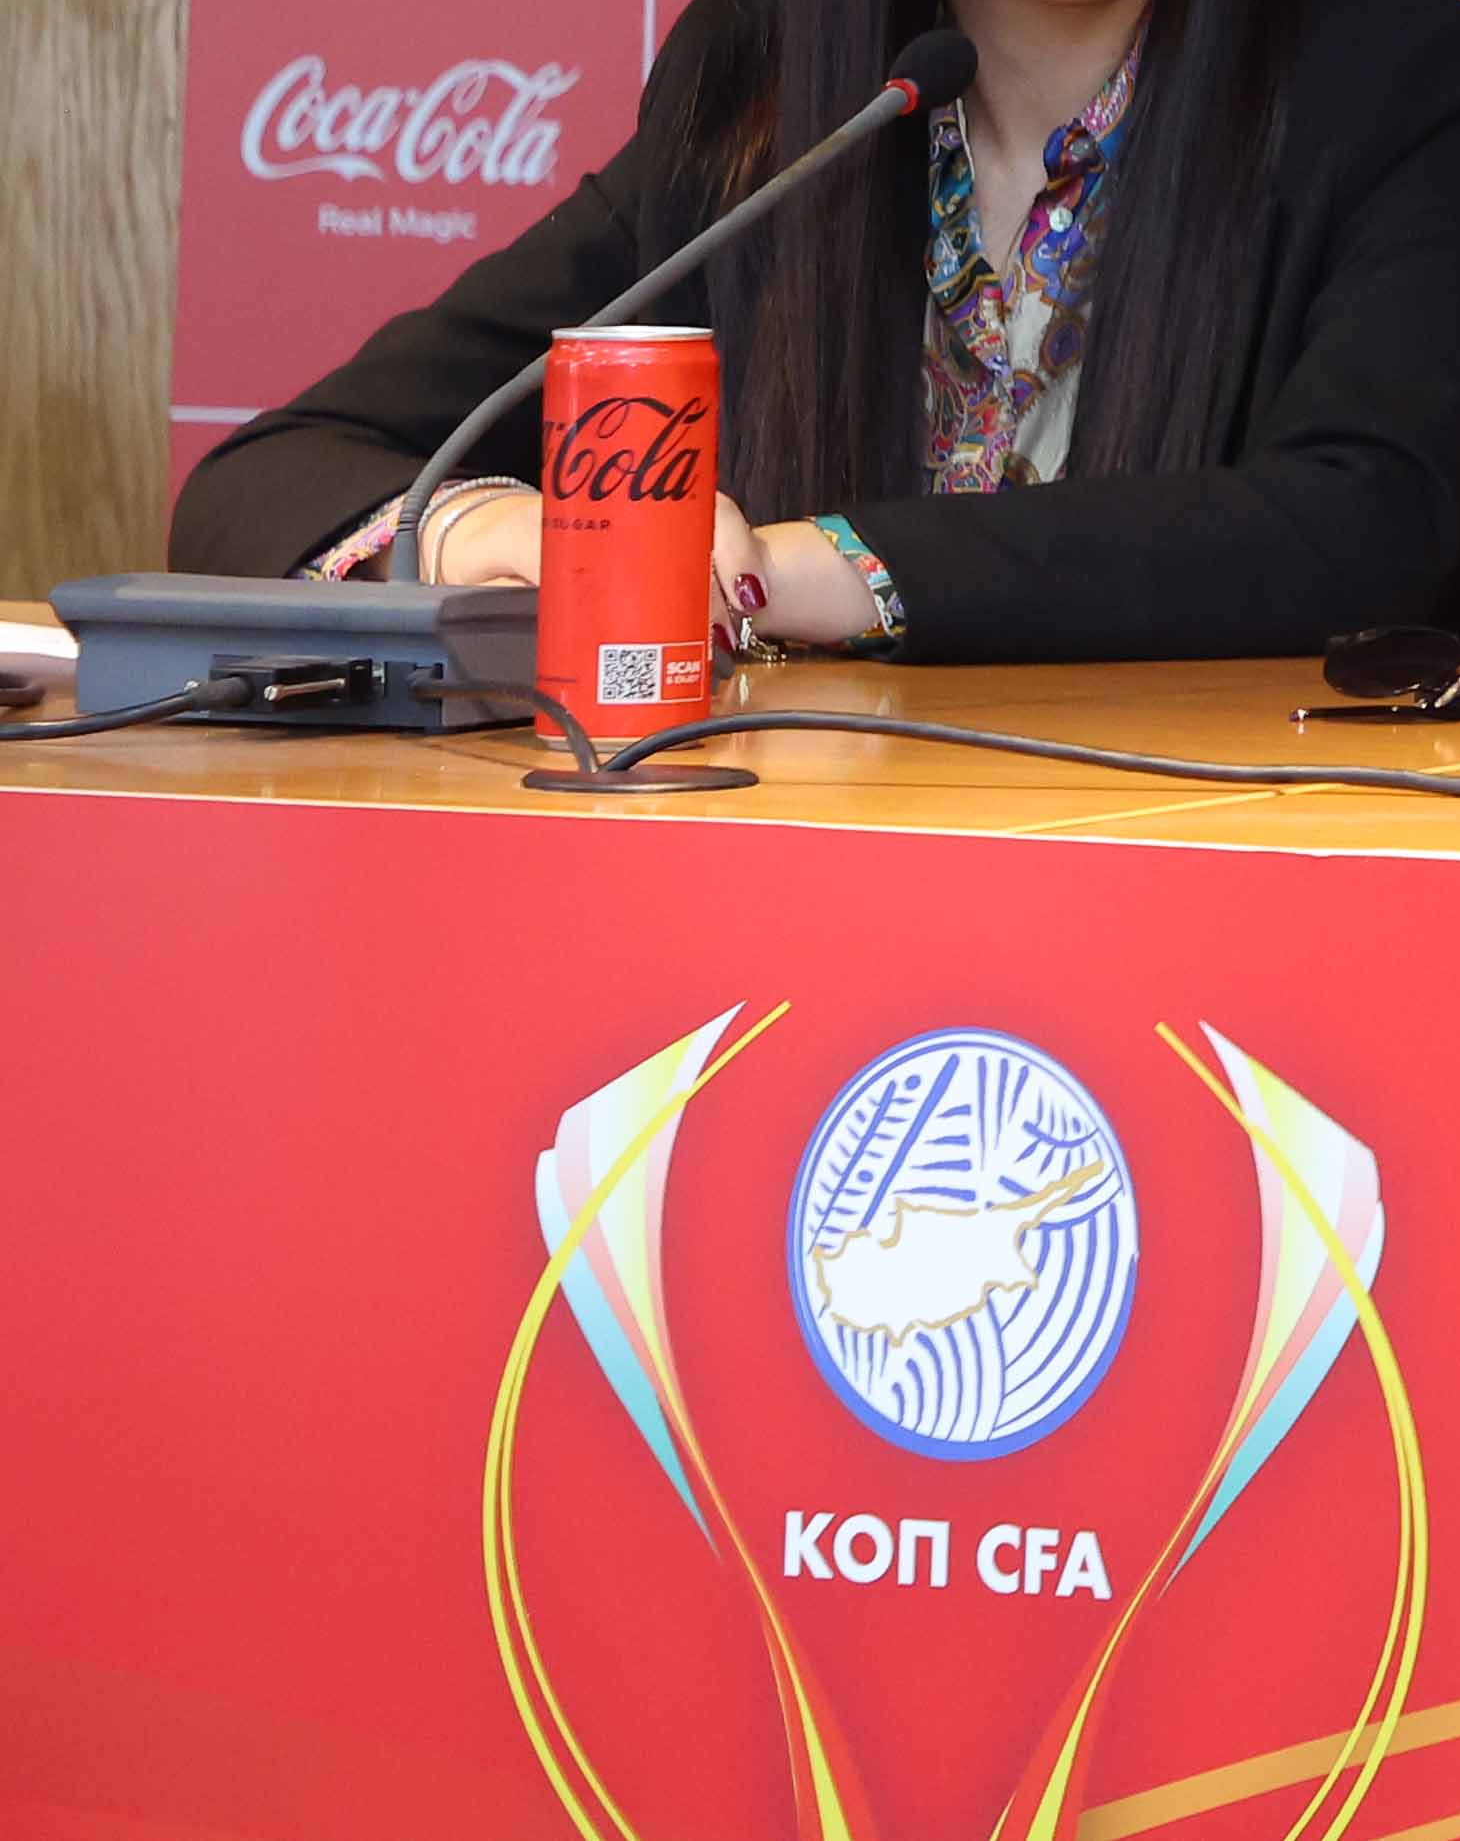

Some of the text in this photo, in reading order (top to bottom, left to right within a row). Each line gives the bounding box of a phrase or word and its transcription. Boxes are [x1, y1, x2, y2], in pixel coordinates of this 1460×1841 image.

[241, 56, 579, 185] Coca-Cola
[783, 1509, 1113, 1601] ΚΟΠ CFA
